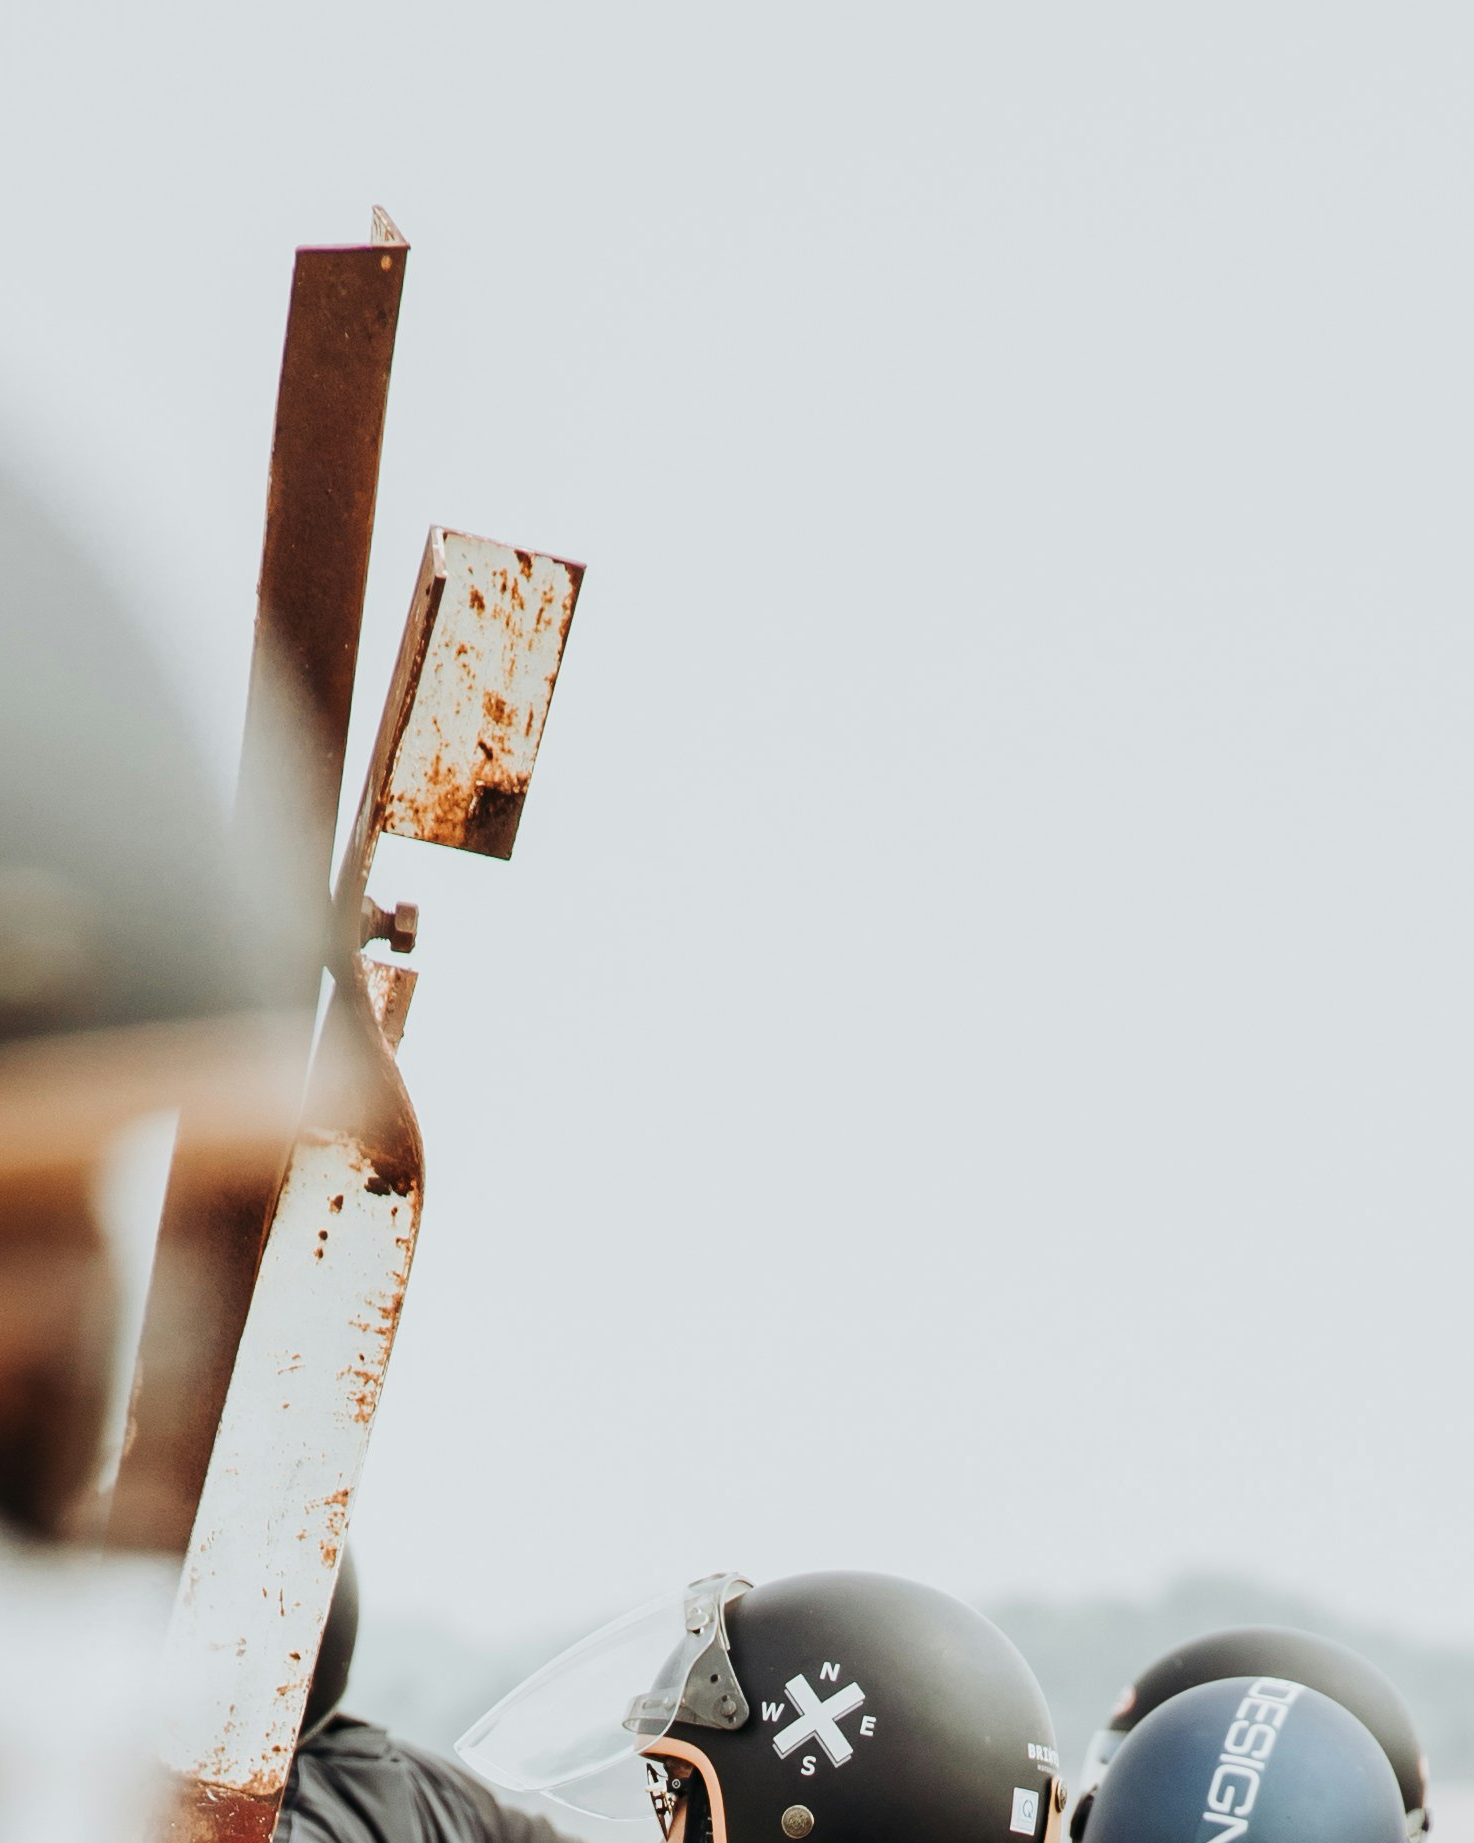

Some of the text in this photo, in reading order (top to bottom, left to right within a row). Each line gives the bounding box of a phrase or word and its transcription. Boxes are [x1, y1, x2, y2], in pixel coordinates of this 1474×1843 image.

[819, 1661, 841, 1682] N
[761, 1701, 785, 1722] W
[859, 1715, 877, 1737] E
[800, 1755, 817, 1776] S
